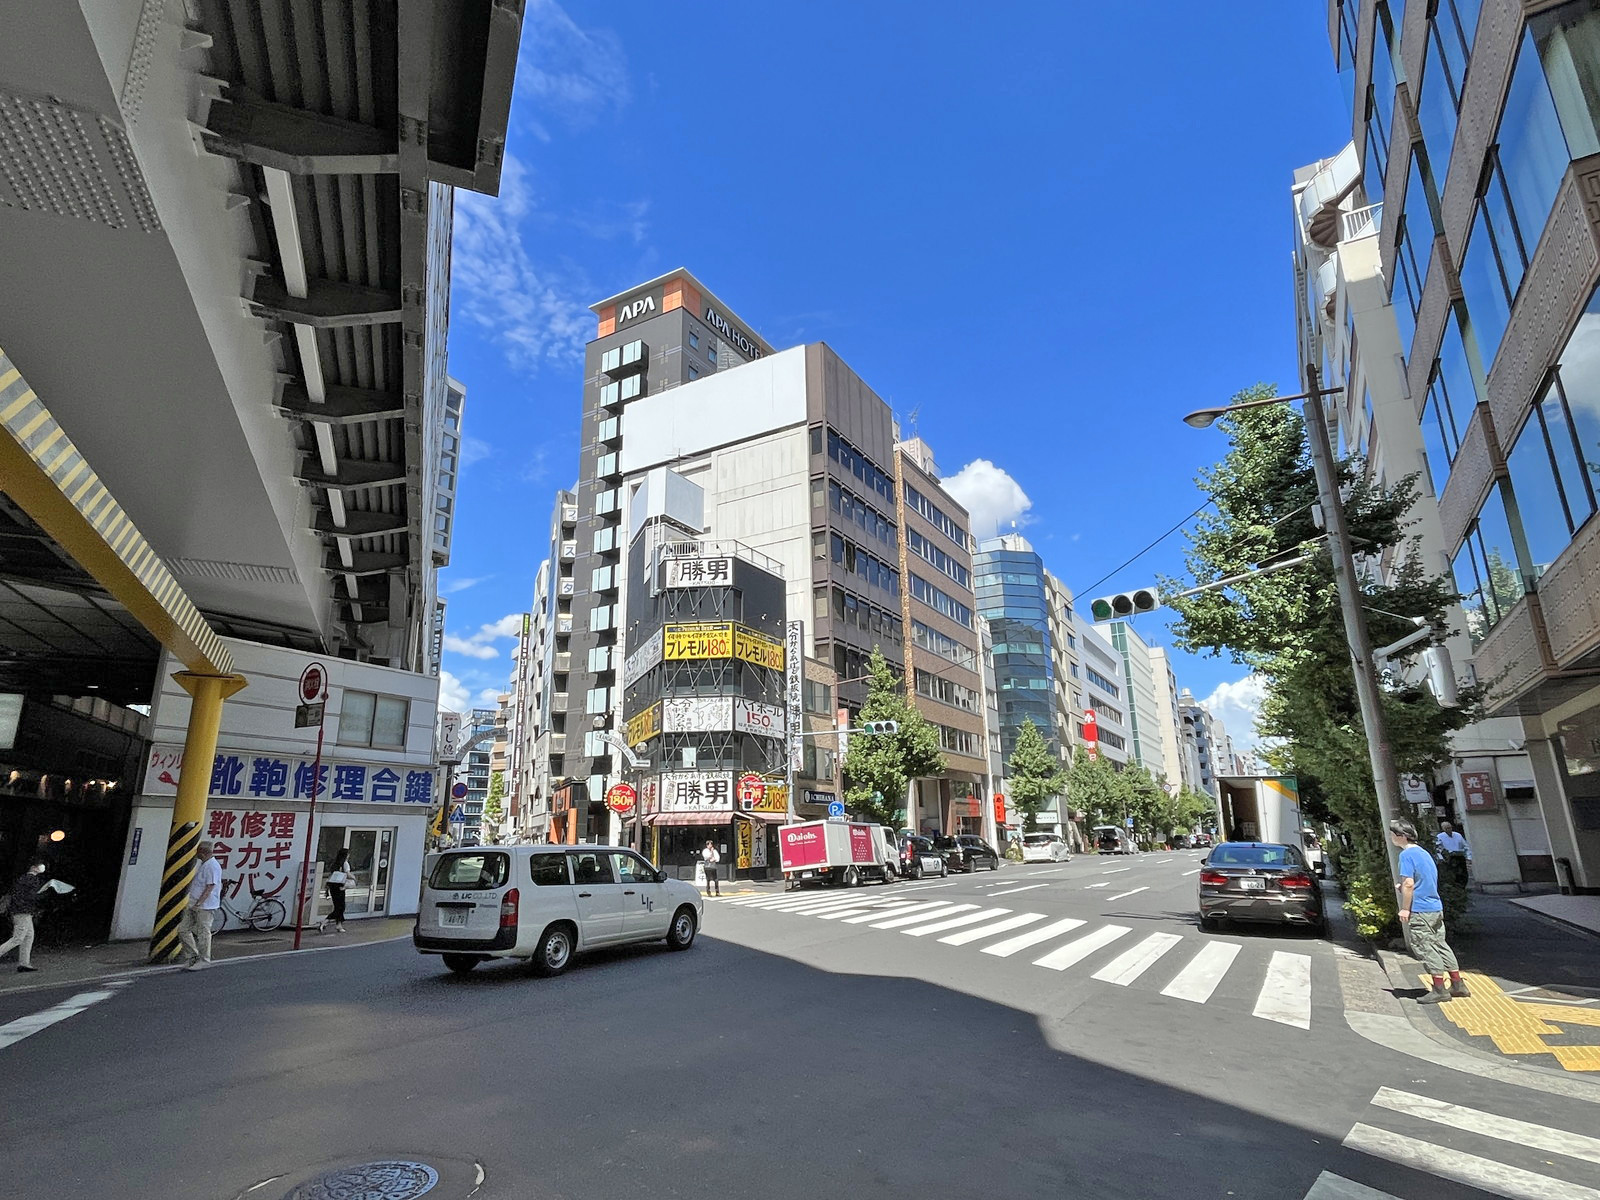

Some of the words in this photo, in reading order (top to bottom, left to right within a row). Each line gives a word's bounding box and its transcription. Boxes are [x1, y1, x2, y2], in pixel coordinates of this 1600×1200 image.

[619, 296, 655, 323] APA
[706, 308, 730, 338] APA
[680, 560, 728, 581] 勝男
[665, 698, 694, 707] 大分
[736, 699, 783, 717] ハイボール
[209, 755, 434, 804] 靴鞄修理合鍵
[674, 780, 728, 805] 勝男
[207, 810, 296, 839] 靴修理
